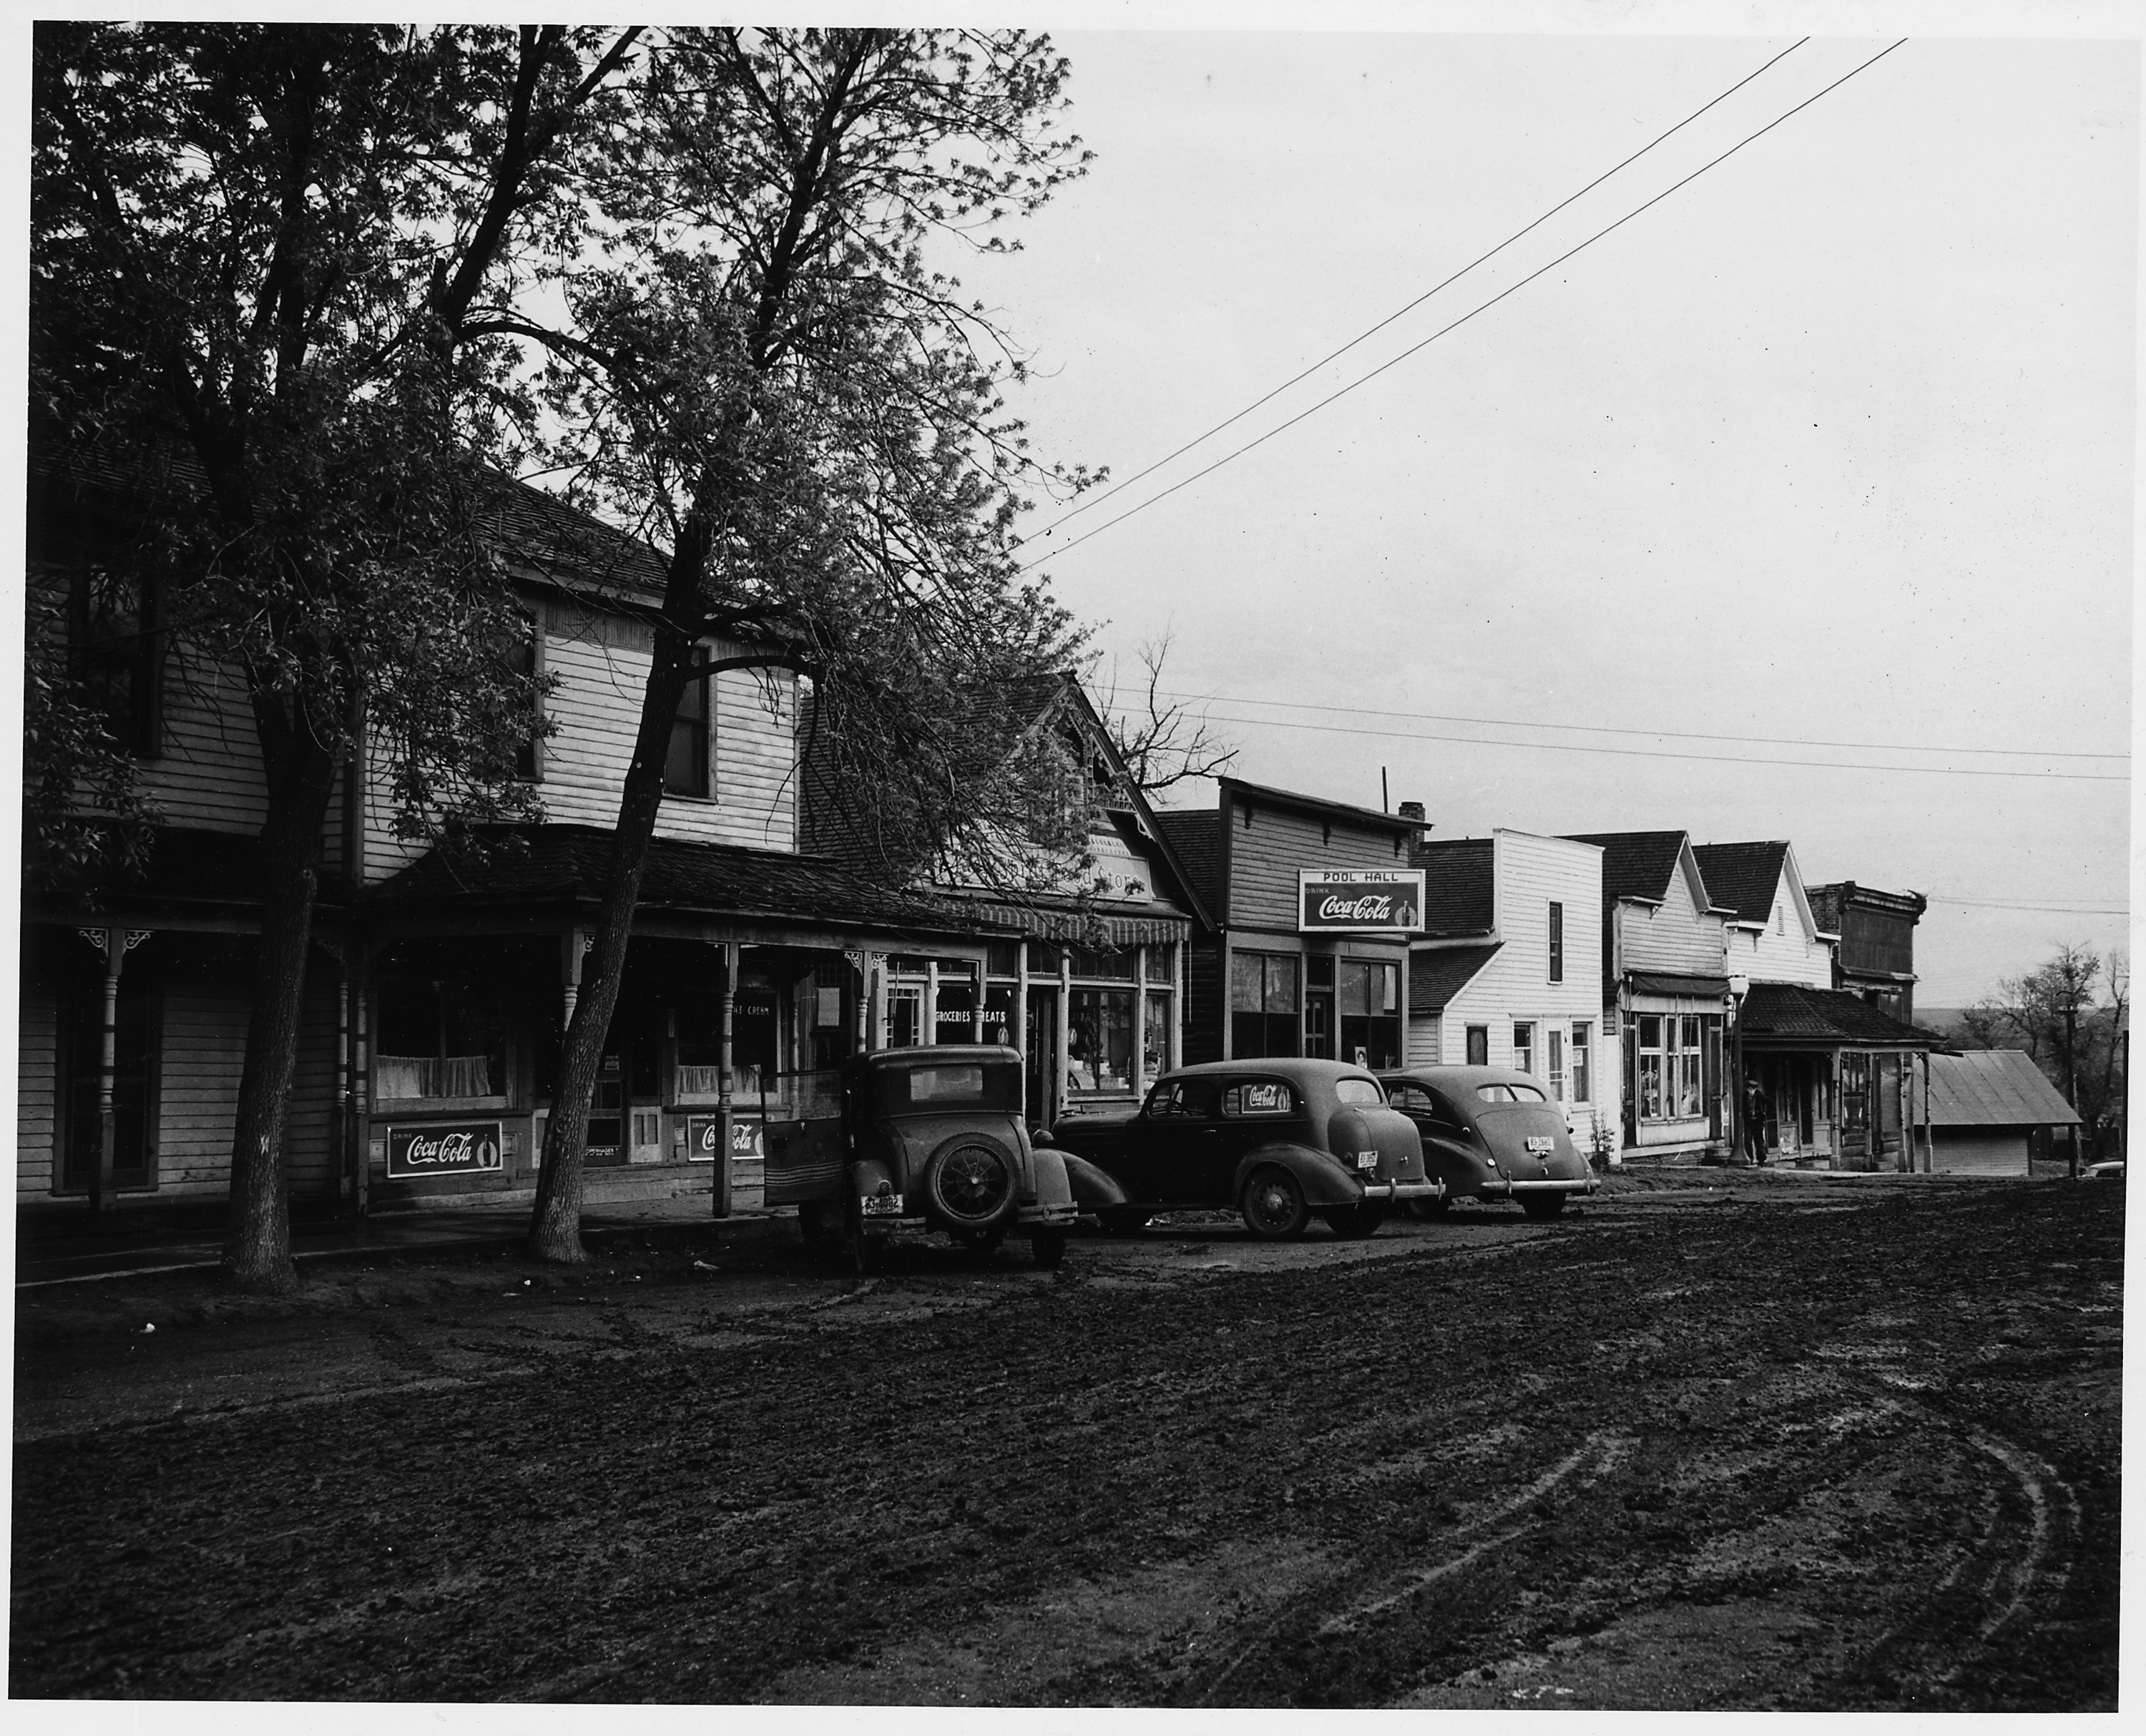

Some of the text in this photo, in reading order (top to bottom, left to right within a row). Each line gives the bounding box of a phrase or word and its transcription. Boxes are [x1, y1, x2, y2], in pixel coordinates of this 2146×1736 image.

[1323, 873, 1356, 881] POOL
[1319, 895, 1393, 920] Coca-Cola
[748, 1006, 769, 1015] CREAM
[936, 1011, 1006, 1023] GROCERIES EATS
[406, 1132, 474, 1165] Coca-Cola
